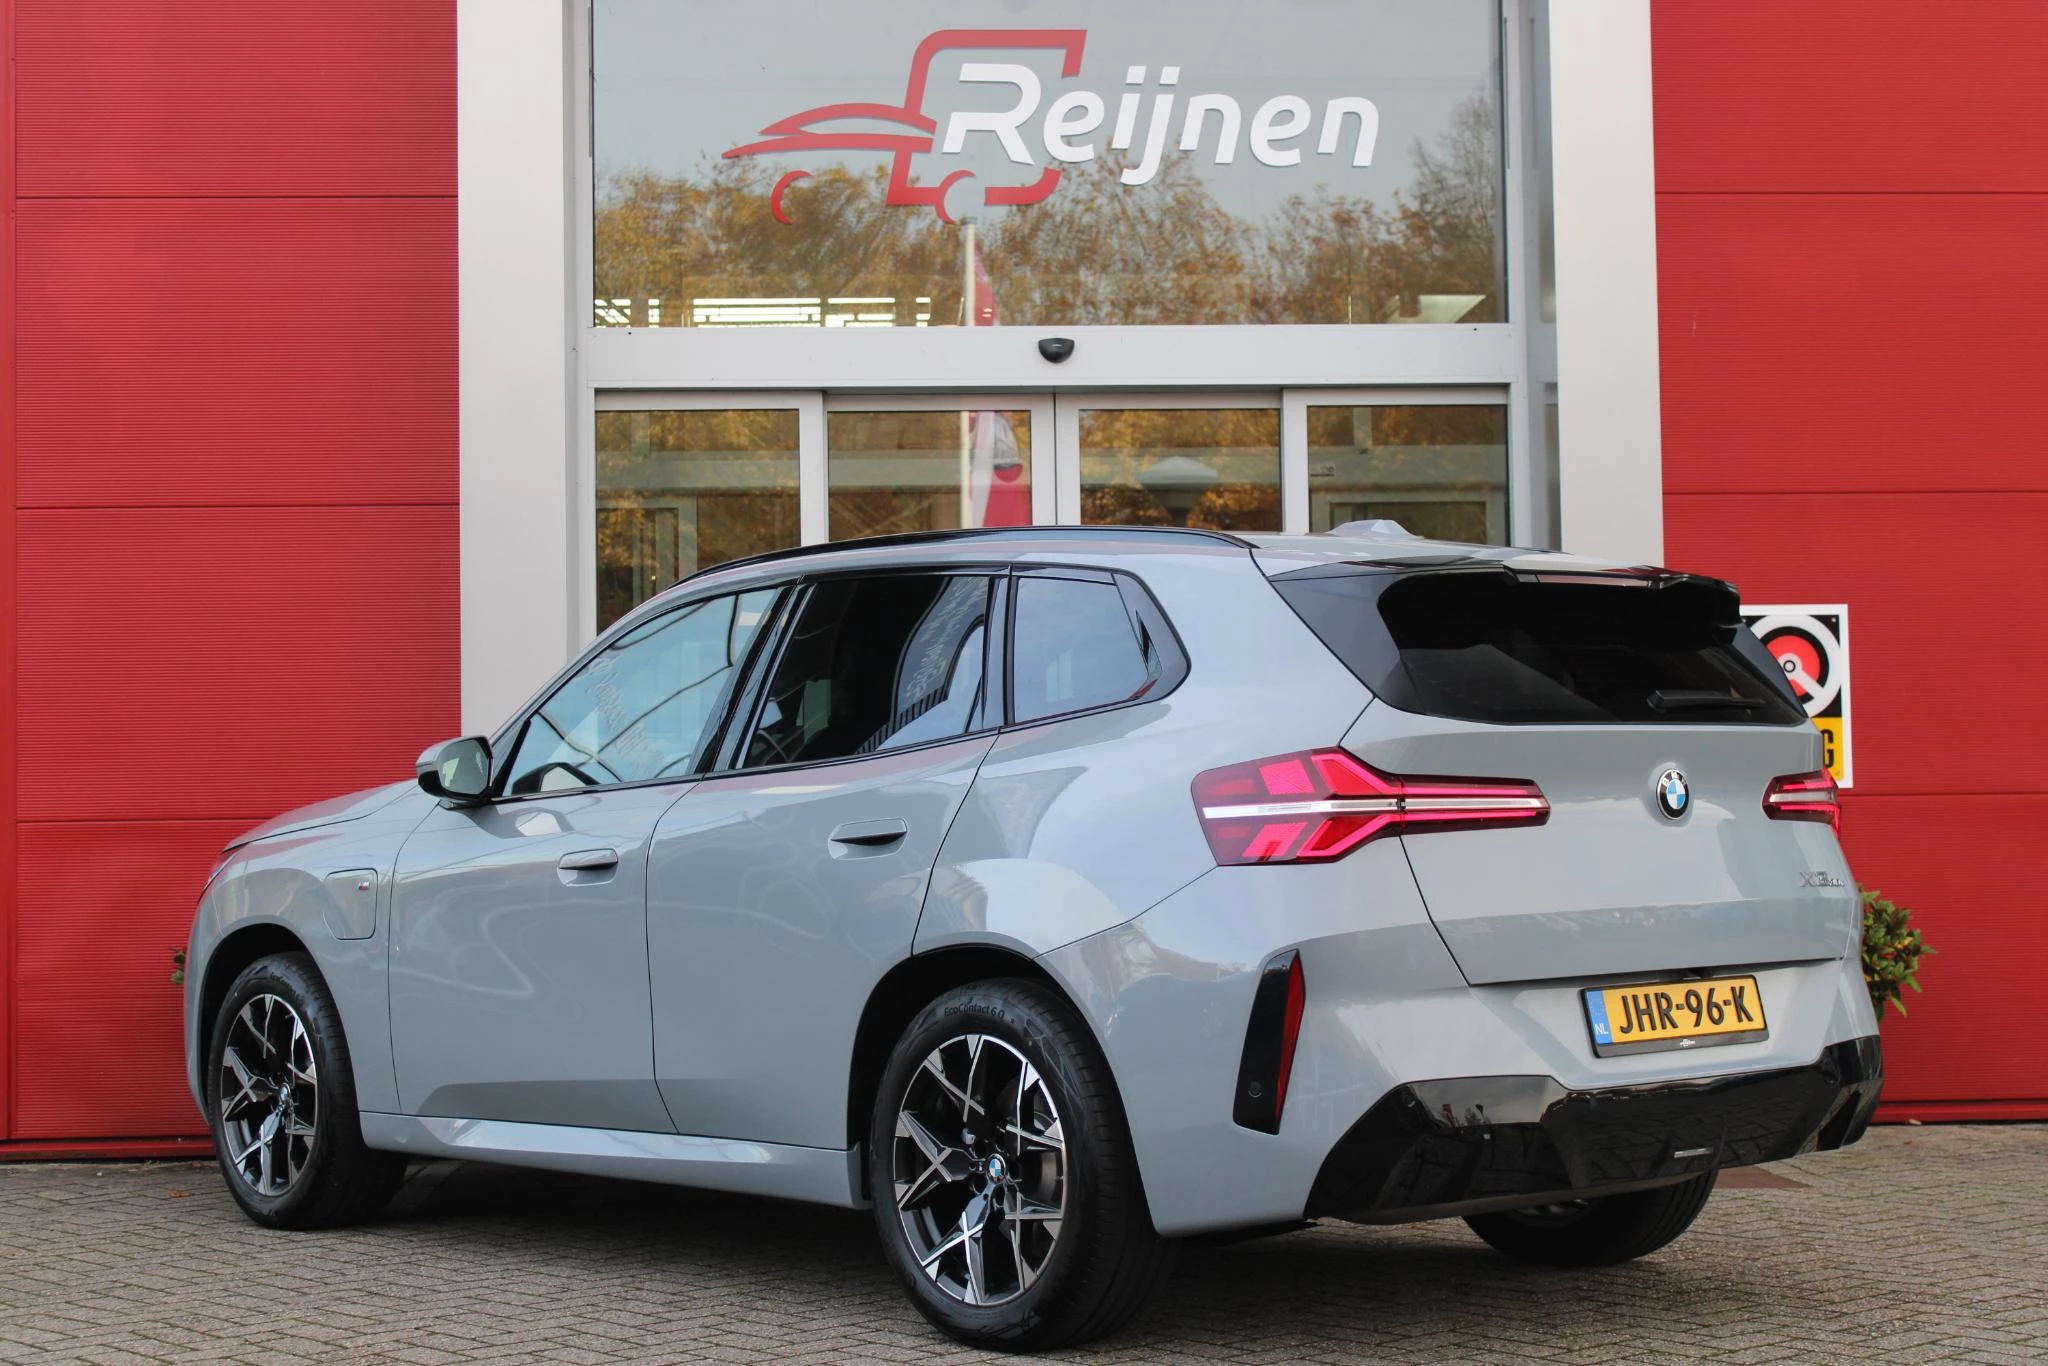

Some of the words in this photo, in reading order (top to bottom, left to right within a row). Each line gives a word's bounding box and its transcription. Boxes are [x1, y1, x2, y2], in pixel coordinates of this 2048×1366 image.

[941, 62, 1380, 187] Reijnen
[943, 1002, 990, 1017] EcoContact
[1619, 985, 1754, 1035] JHR-96-K
[1594, 1022, 1609, 1035] NL
